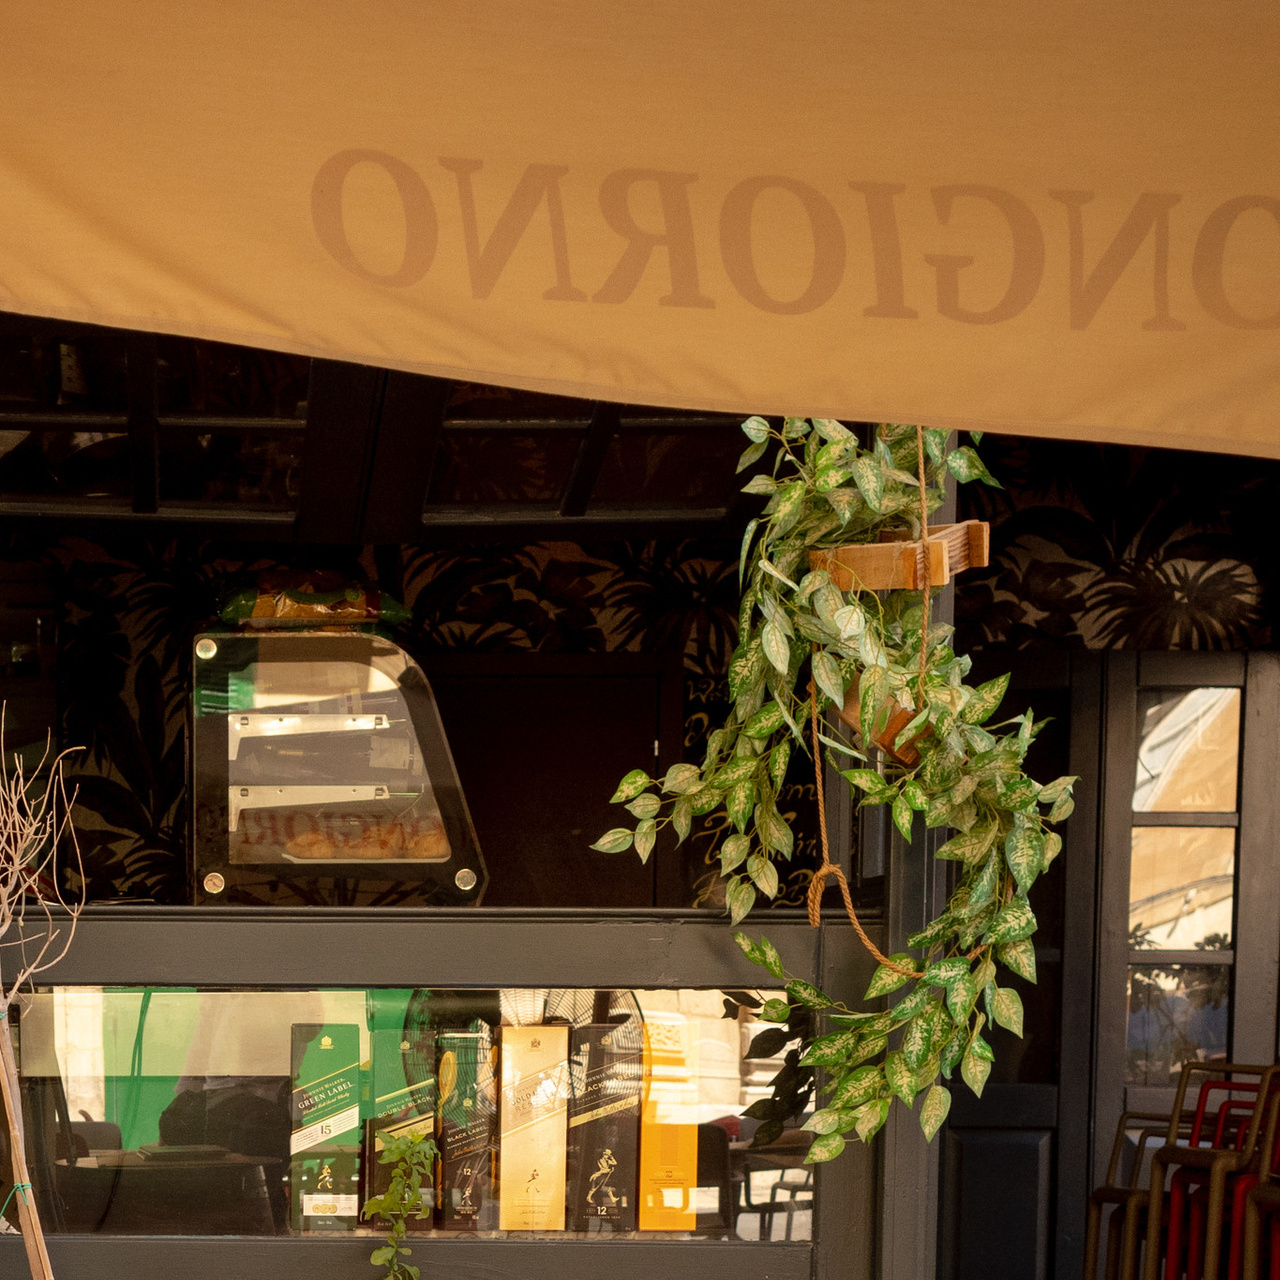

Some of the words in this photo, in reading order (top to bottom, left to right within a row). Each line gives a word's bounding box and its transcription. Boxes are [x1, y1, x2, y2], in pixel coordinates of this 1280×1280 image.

[298, 1092, 326, 1109] GREEN
[327, 1081, 354, 1097] LABEL
[377, 1105, 406, 1119] DOUBLE
[406, 1095, 433, 1109] BLACK
[320, 1125, 332, 1135] 15
[446, 1131, 468, 1143] BLACK
[463, 1168, 472, 1176] 12
[596, 1206, 607, 1215] 12
